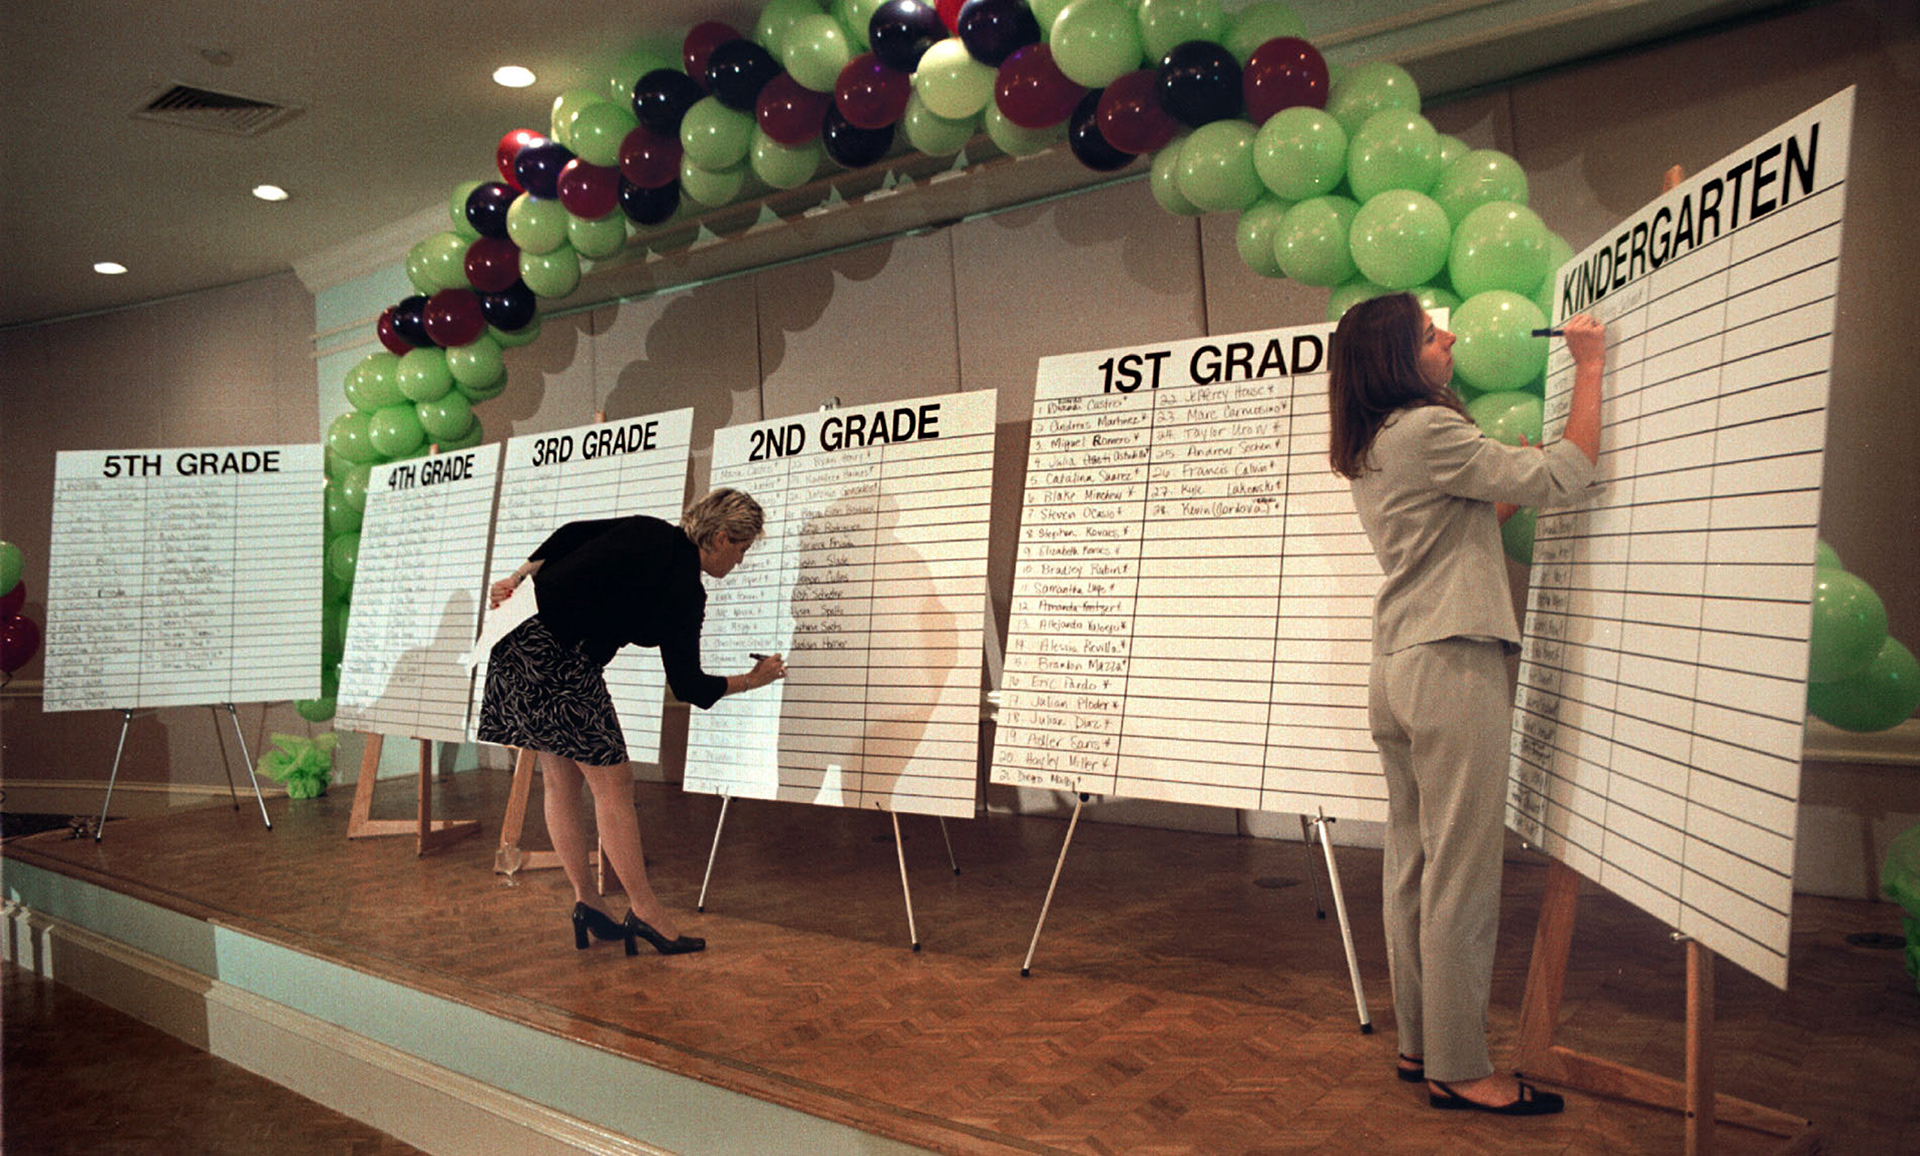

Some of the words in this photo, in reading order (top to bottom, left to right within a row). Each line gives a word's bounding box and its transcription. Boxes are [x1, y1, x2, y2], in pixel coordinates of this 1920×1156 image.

[1561, 122, 1819, 321] KINDERGARTEN
[1098, 351, 1171, 394] 1ST
[1190, 332, 1335, 385] GRAD
[1187, 408, 1217, 422] Marc
[749, 424, 805, 461] 2ND
[820, 404, 940, 451] GRADE
[1184, 426, 1227, 441] Taylor
[533, 436, 573, 466] 3RD
[583, 421, 658, 460] GRADE
[1093, 434, 1130, 446] Romero
[1188, 444, 1232, 457] Andrew
[103, 455, 161, 477] 5TH
[176, 451, 280, 476] GRADE
[1182, 463, 1228, 477] Francis
[389, 465, 416, 491] 4TH
[421, 454, 475, 486] GRADE
[1046, 471, 1094, 484] Catalina
[1099, 470, 1131, 482] Suarez
[1045, 491, 1075, 503] Blake
[1040, 509, 1076, 520] Steven
[1042, 564, 1082, 578] Bradley
[1039, 658, 1083, 671] Brandon
[1089, 660, 1122, 672] Mazza
[1032, 676, 1056, 689] Eric
[1031, 696, 1067, 709] Julian
